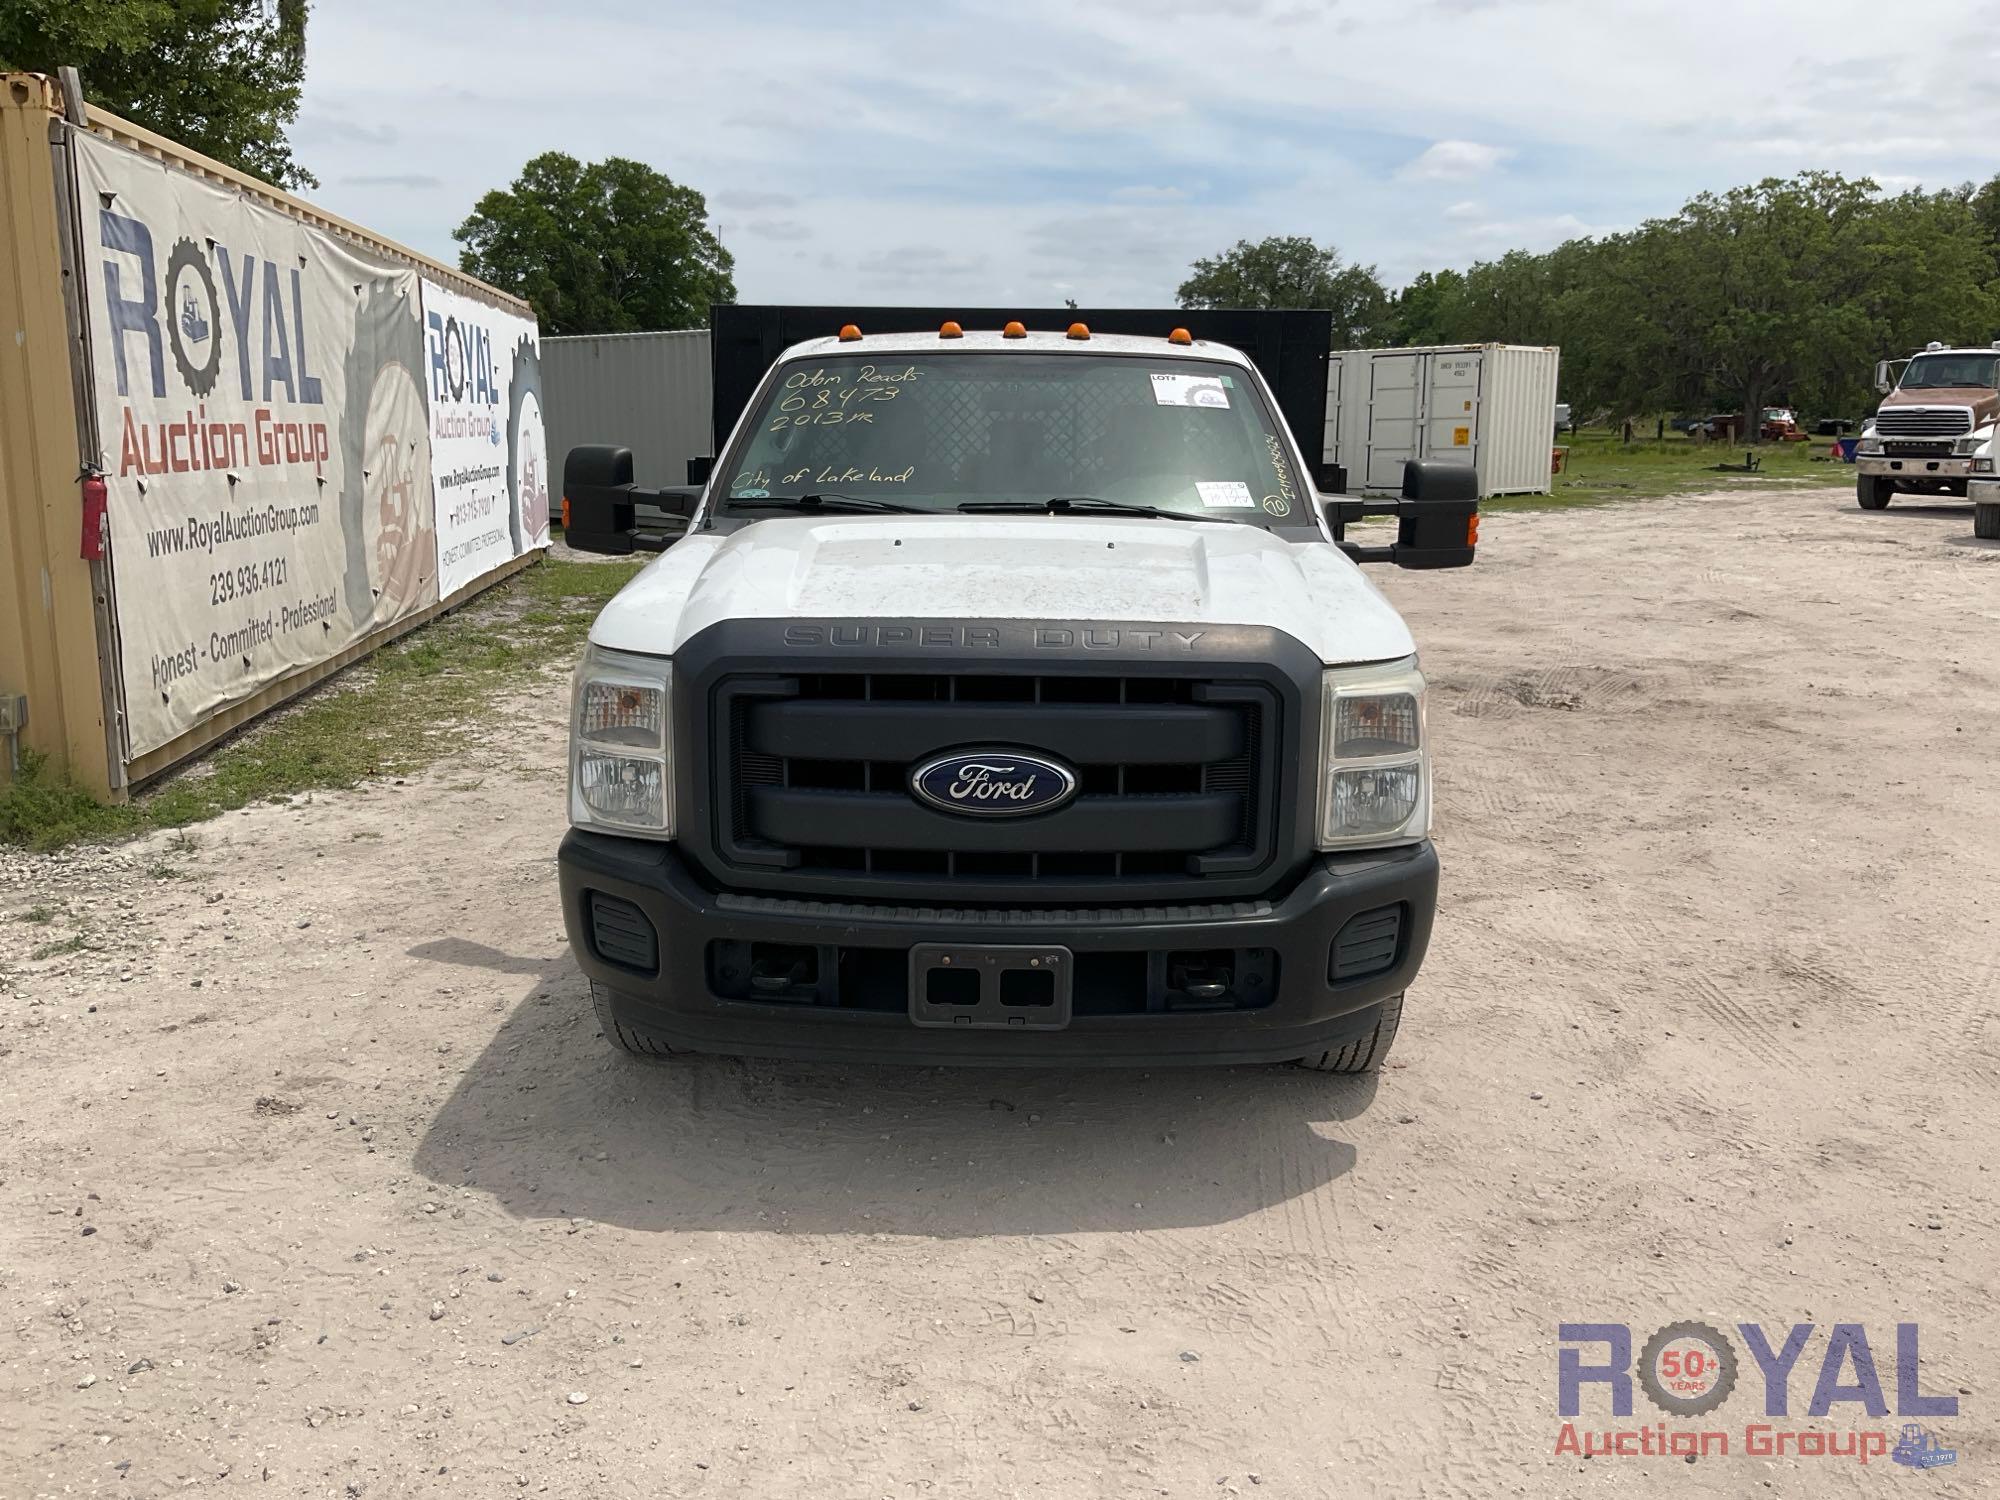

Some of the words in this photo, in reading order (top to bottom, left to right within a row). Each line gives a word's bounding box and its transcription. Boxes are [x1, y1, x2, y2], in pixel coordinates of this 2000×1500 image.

[99, 208, 323, 404] ROYAL
[428, 310, 499, 404] ROYAL
[786, 368, 841, 389] Odom
[857, 365, 925, 382] Reads
[780, 386, 900, 412] 68473
[120, 404, 249, 477] Auction
[254, 408, 329, 473] Group
[436, 410, 466, 439] Auction
[467, 411, 491, 442] Group
[731, 471, 770, 489] City
[781, 468, 810, 484] of
[147, 502, 319, 557] www.RoyalAuctionGroup.com
[209, 558, 288, 605] 239.936.4121
[151, 642, 199, 689] Honest
[210, 610, 272, 663] Committed
[281, 587, 337, 633] Professional
[783, 624, 1000, 648] SUPER
[1033, 626, 1207, 651] DUTY
[948, 763, 1036, 801] Ford
